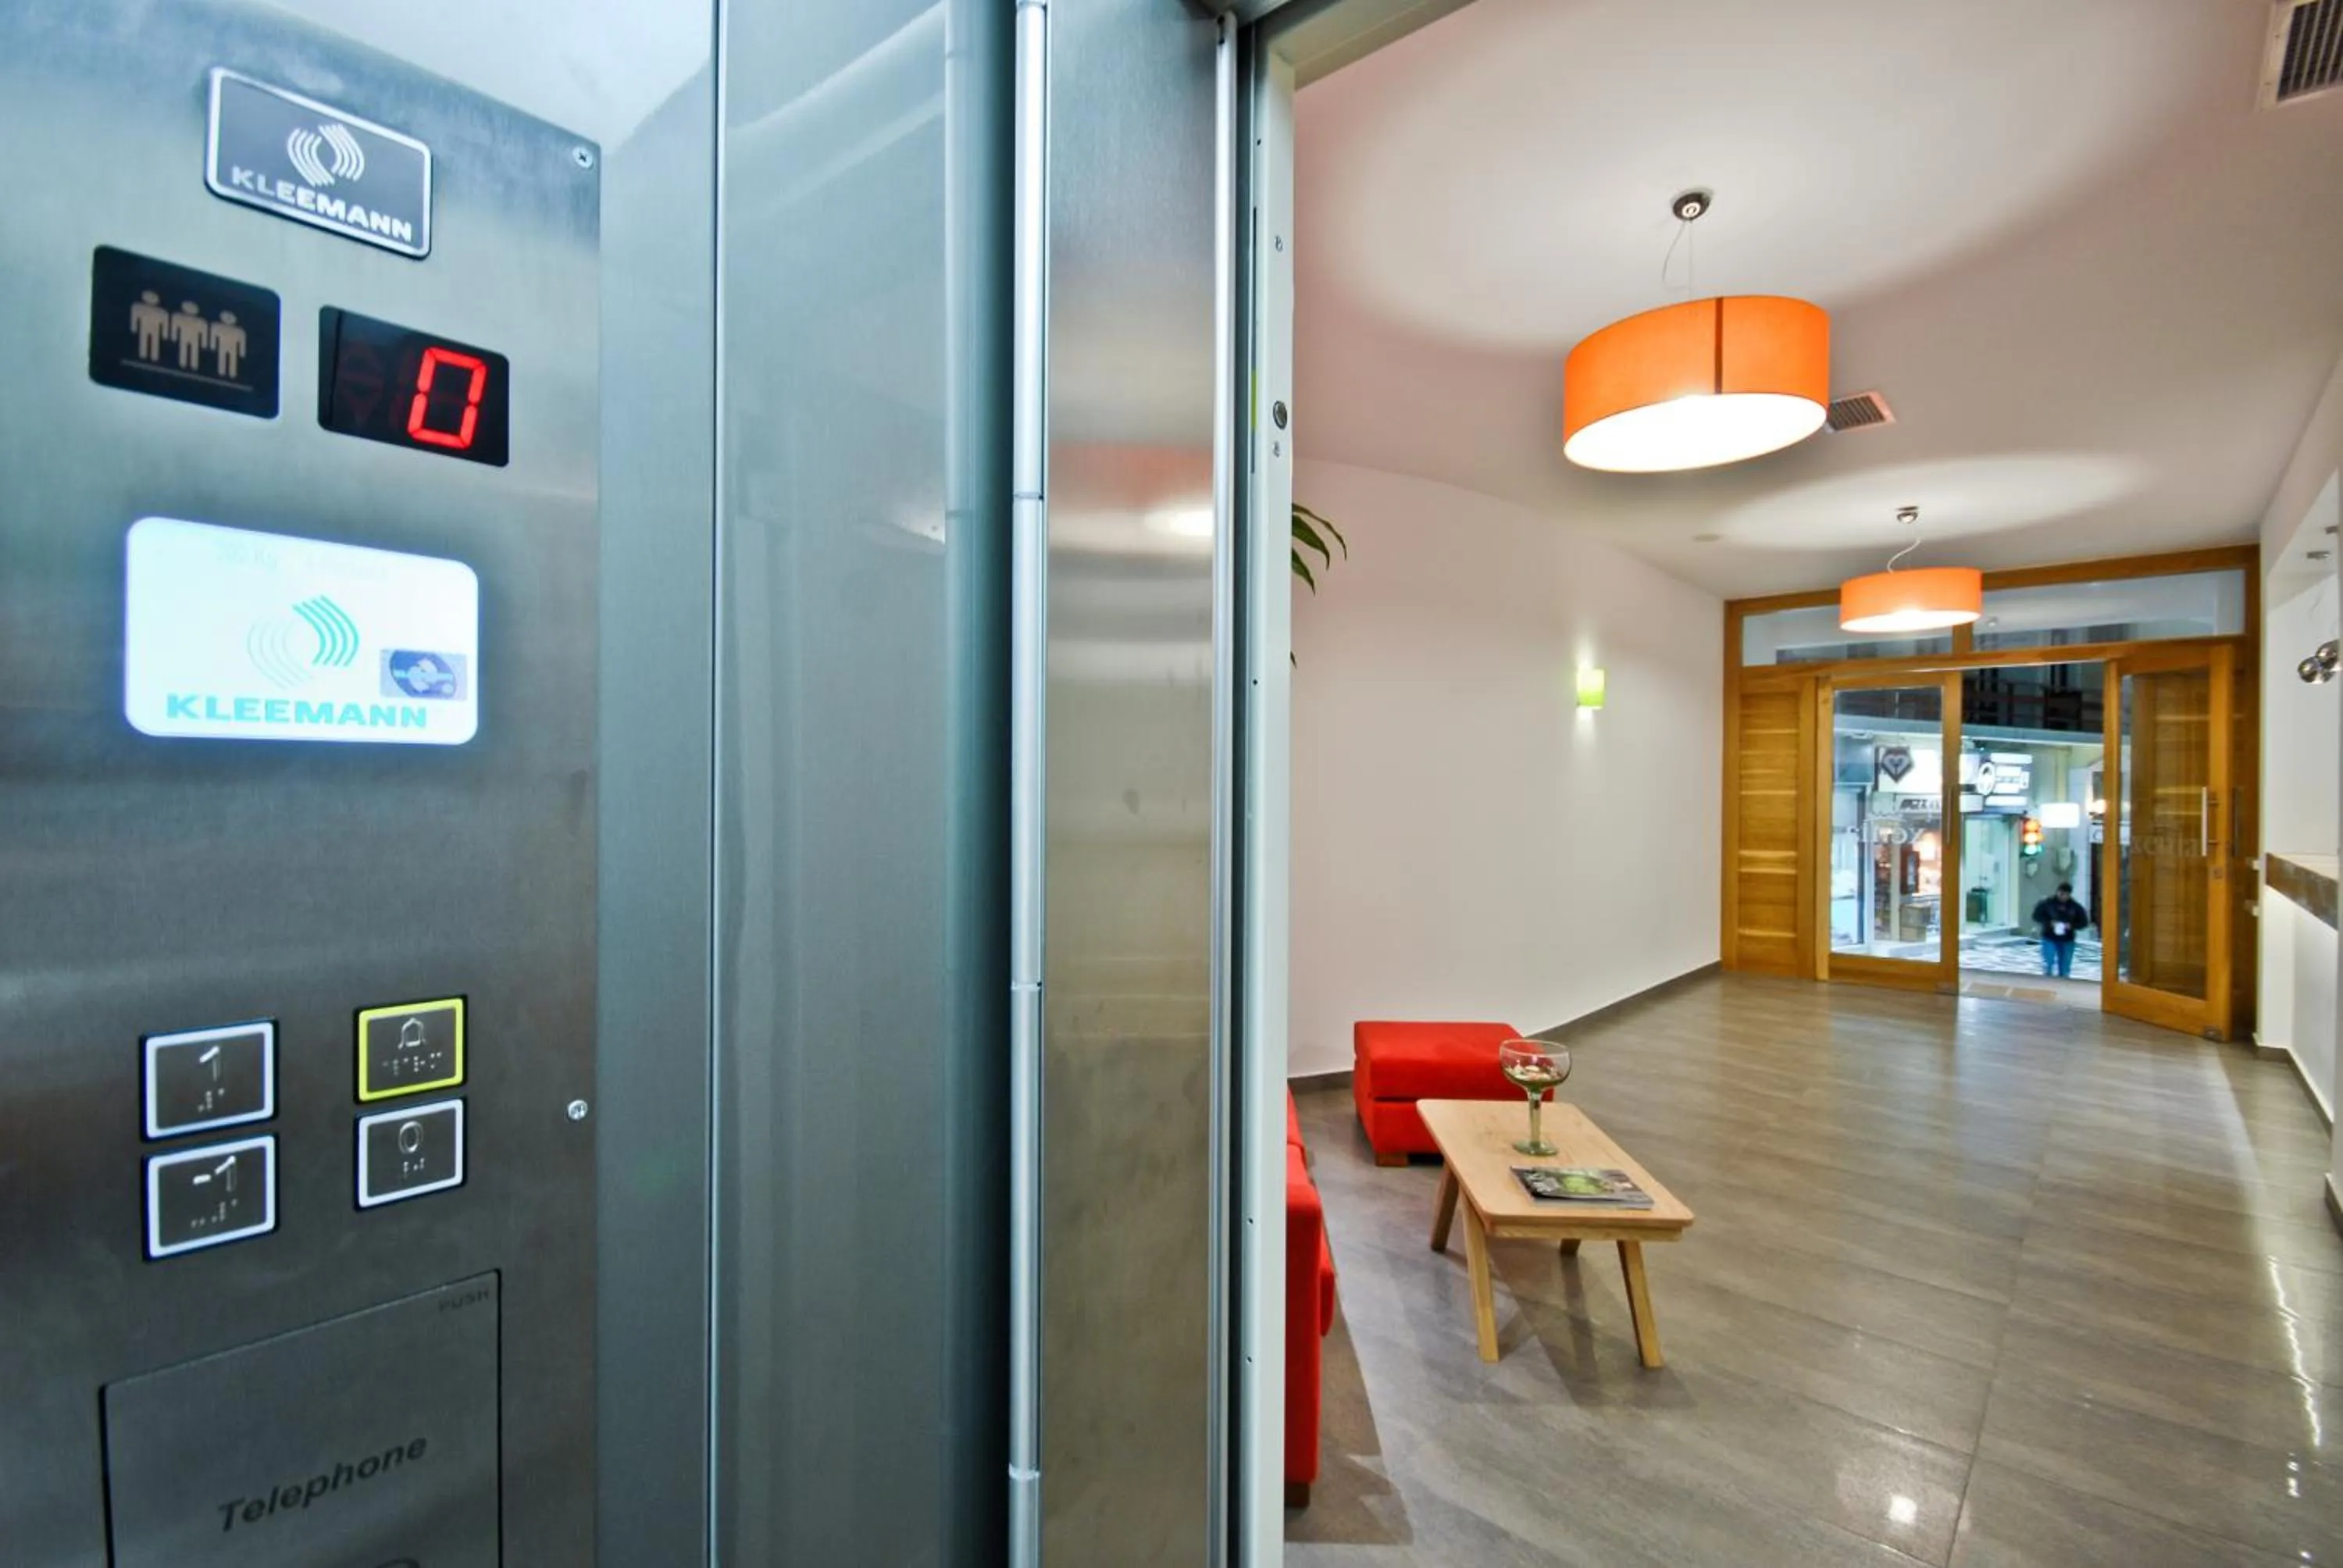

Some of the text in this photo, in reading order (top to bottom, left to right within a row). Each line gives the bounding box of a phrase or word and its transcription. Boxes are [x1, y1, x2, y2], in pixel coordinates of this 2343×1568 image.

[230, 165, 413, 242] KLEEMANN
[408, 346, 488, 450] 0
[166, 693, 428, 729] KLEEMANN
[199, 1045, 221, 1082] 1
[438, 1289, 490, 1313] PUSH
[218, 1437, 427, 1531] Telephone
